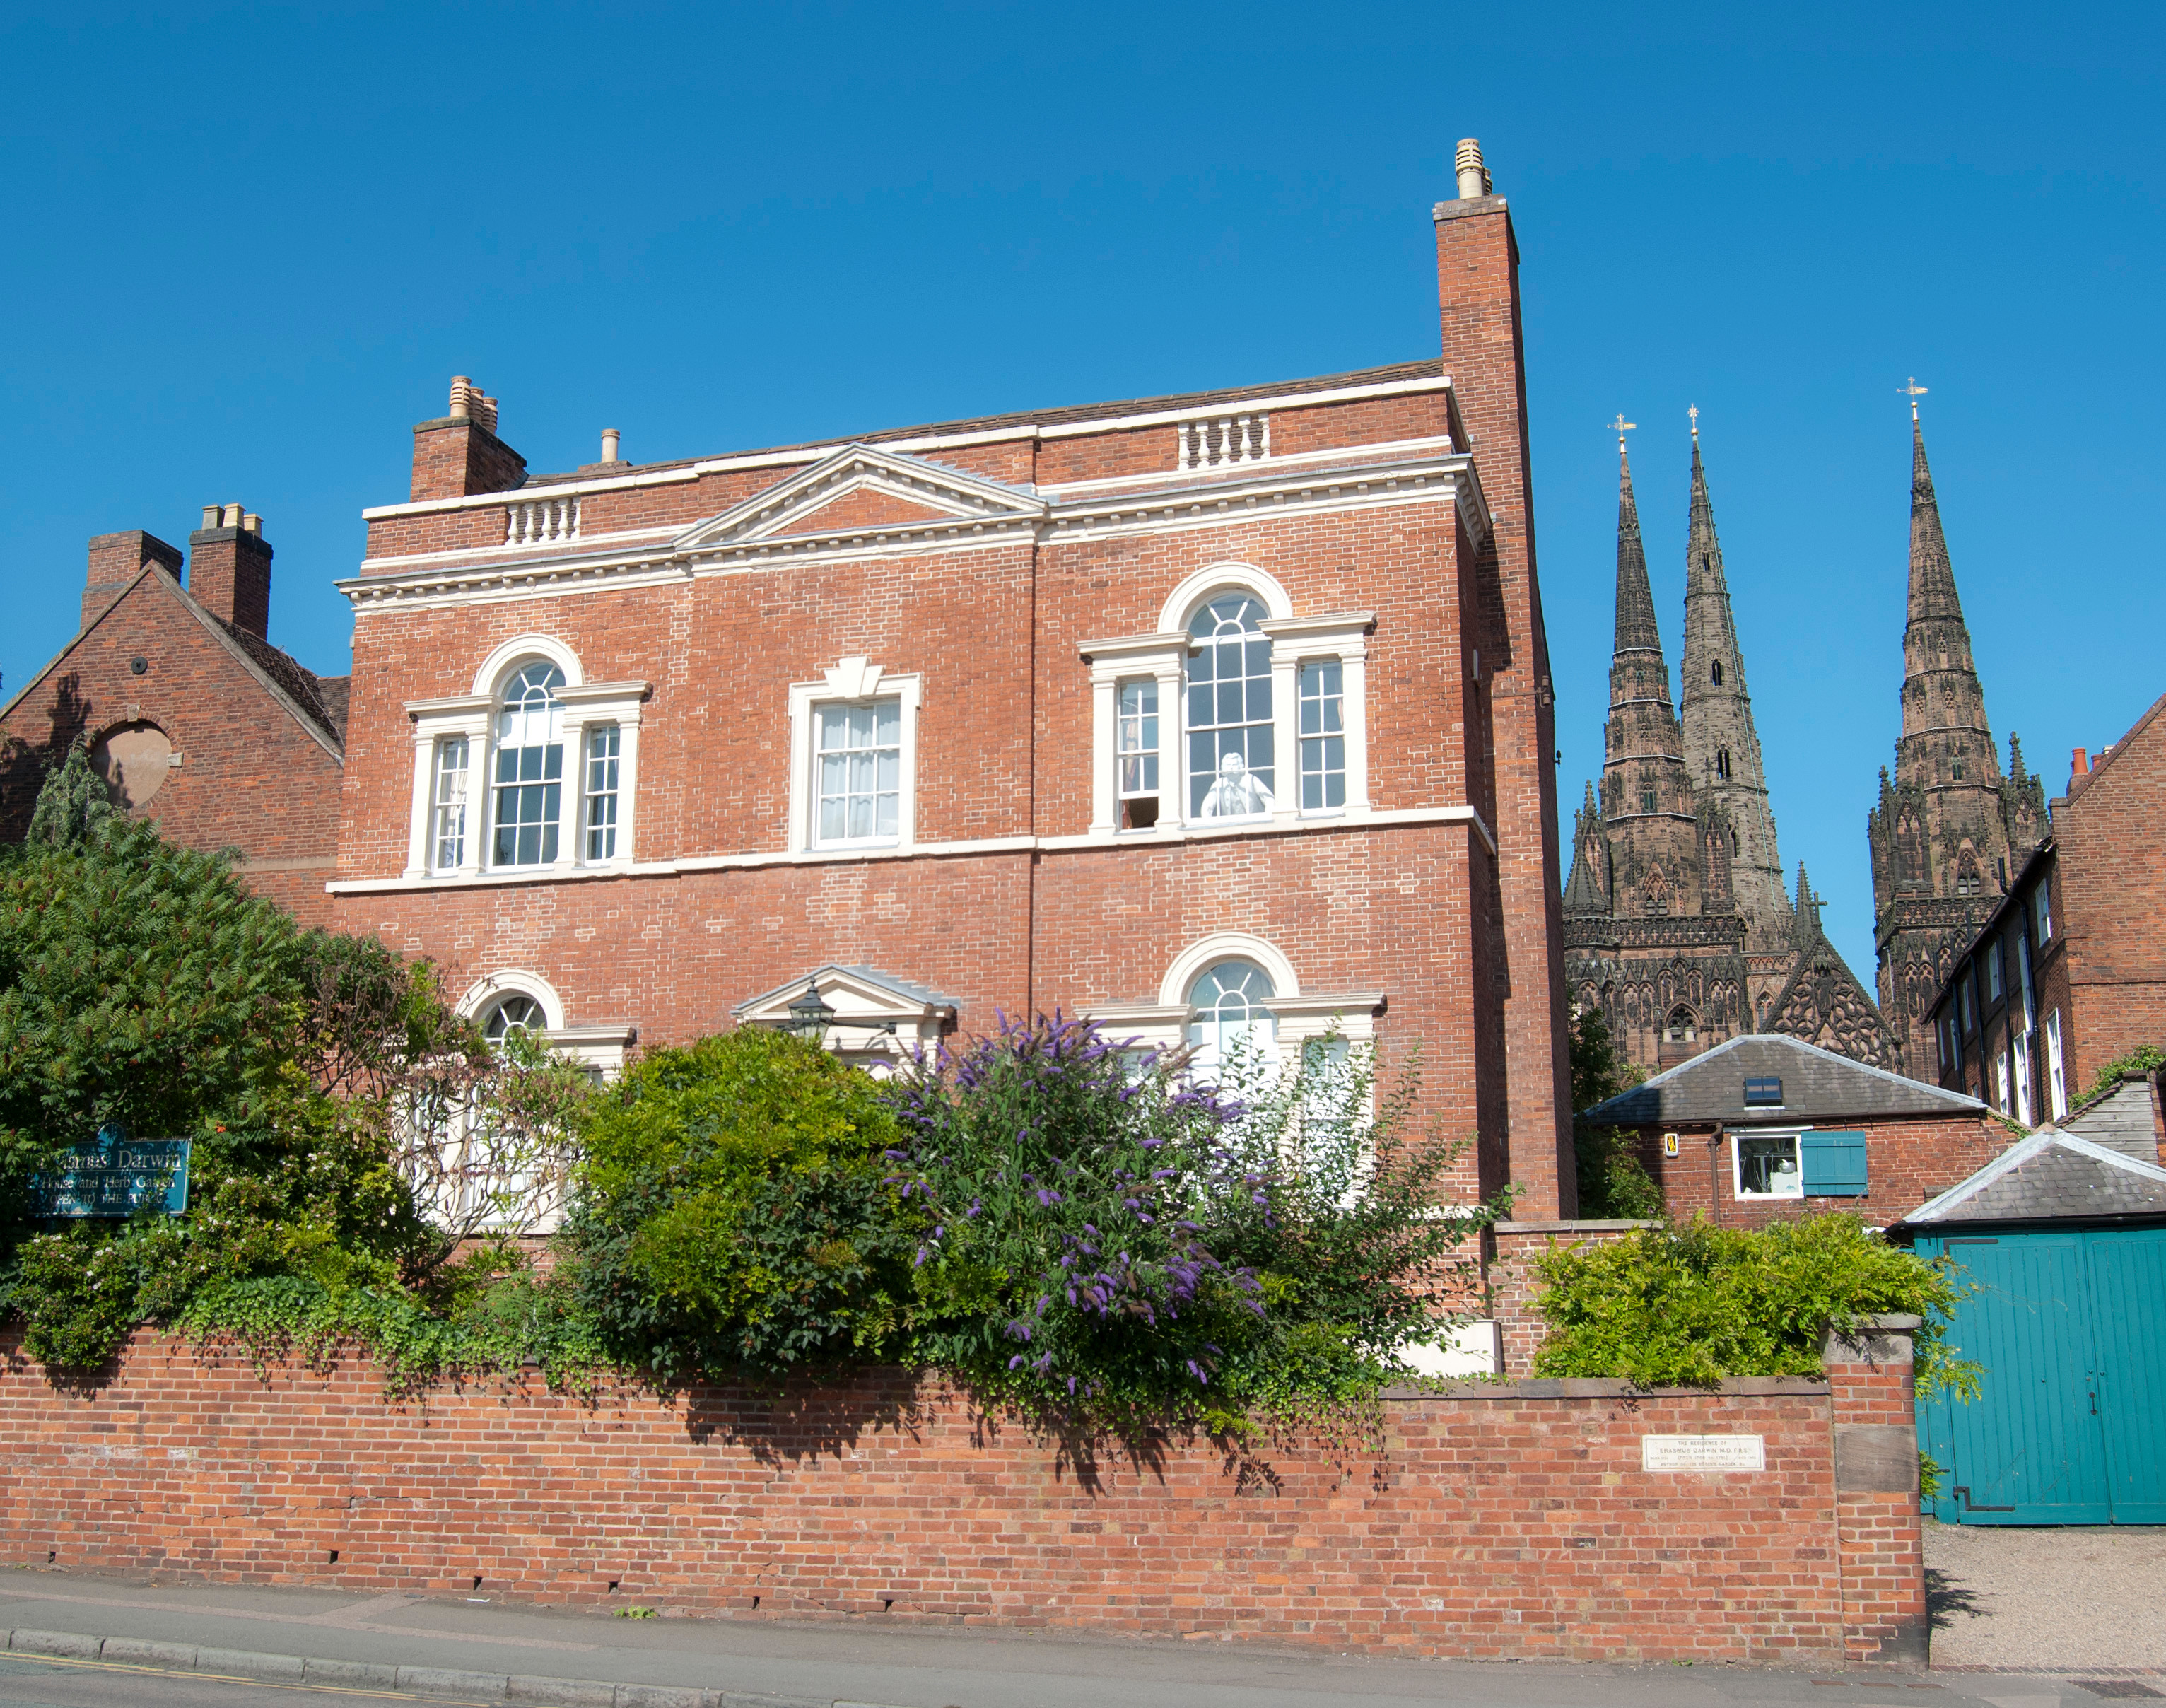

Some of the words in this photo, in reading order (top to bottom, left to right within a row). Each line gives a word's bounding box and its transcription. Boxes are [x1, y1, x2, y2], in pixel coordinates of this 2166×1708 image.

[117, 1150, 182, 1169] Darwin
[42, 1176, 74, 1189] House
[78, 1176, 98, 1188] and
[104, 1175, 131, 1188] Herb
[50, 1194, 76, 1205] OPEN
[81, 1193, 95, 1205] TO
[100, 1193, 122, 1204] THE
